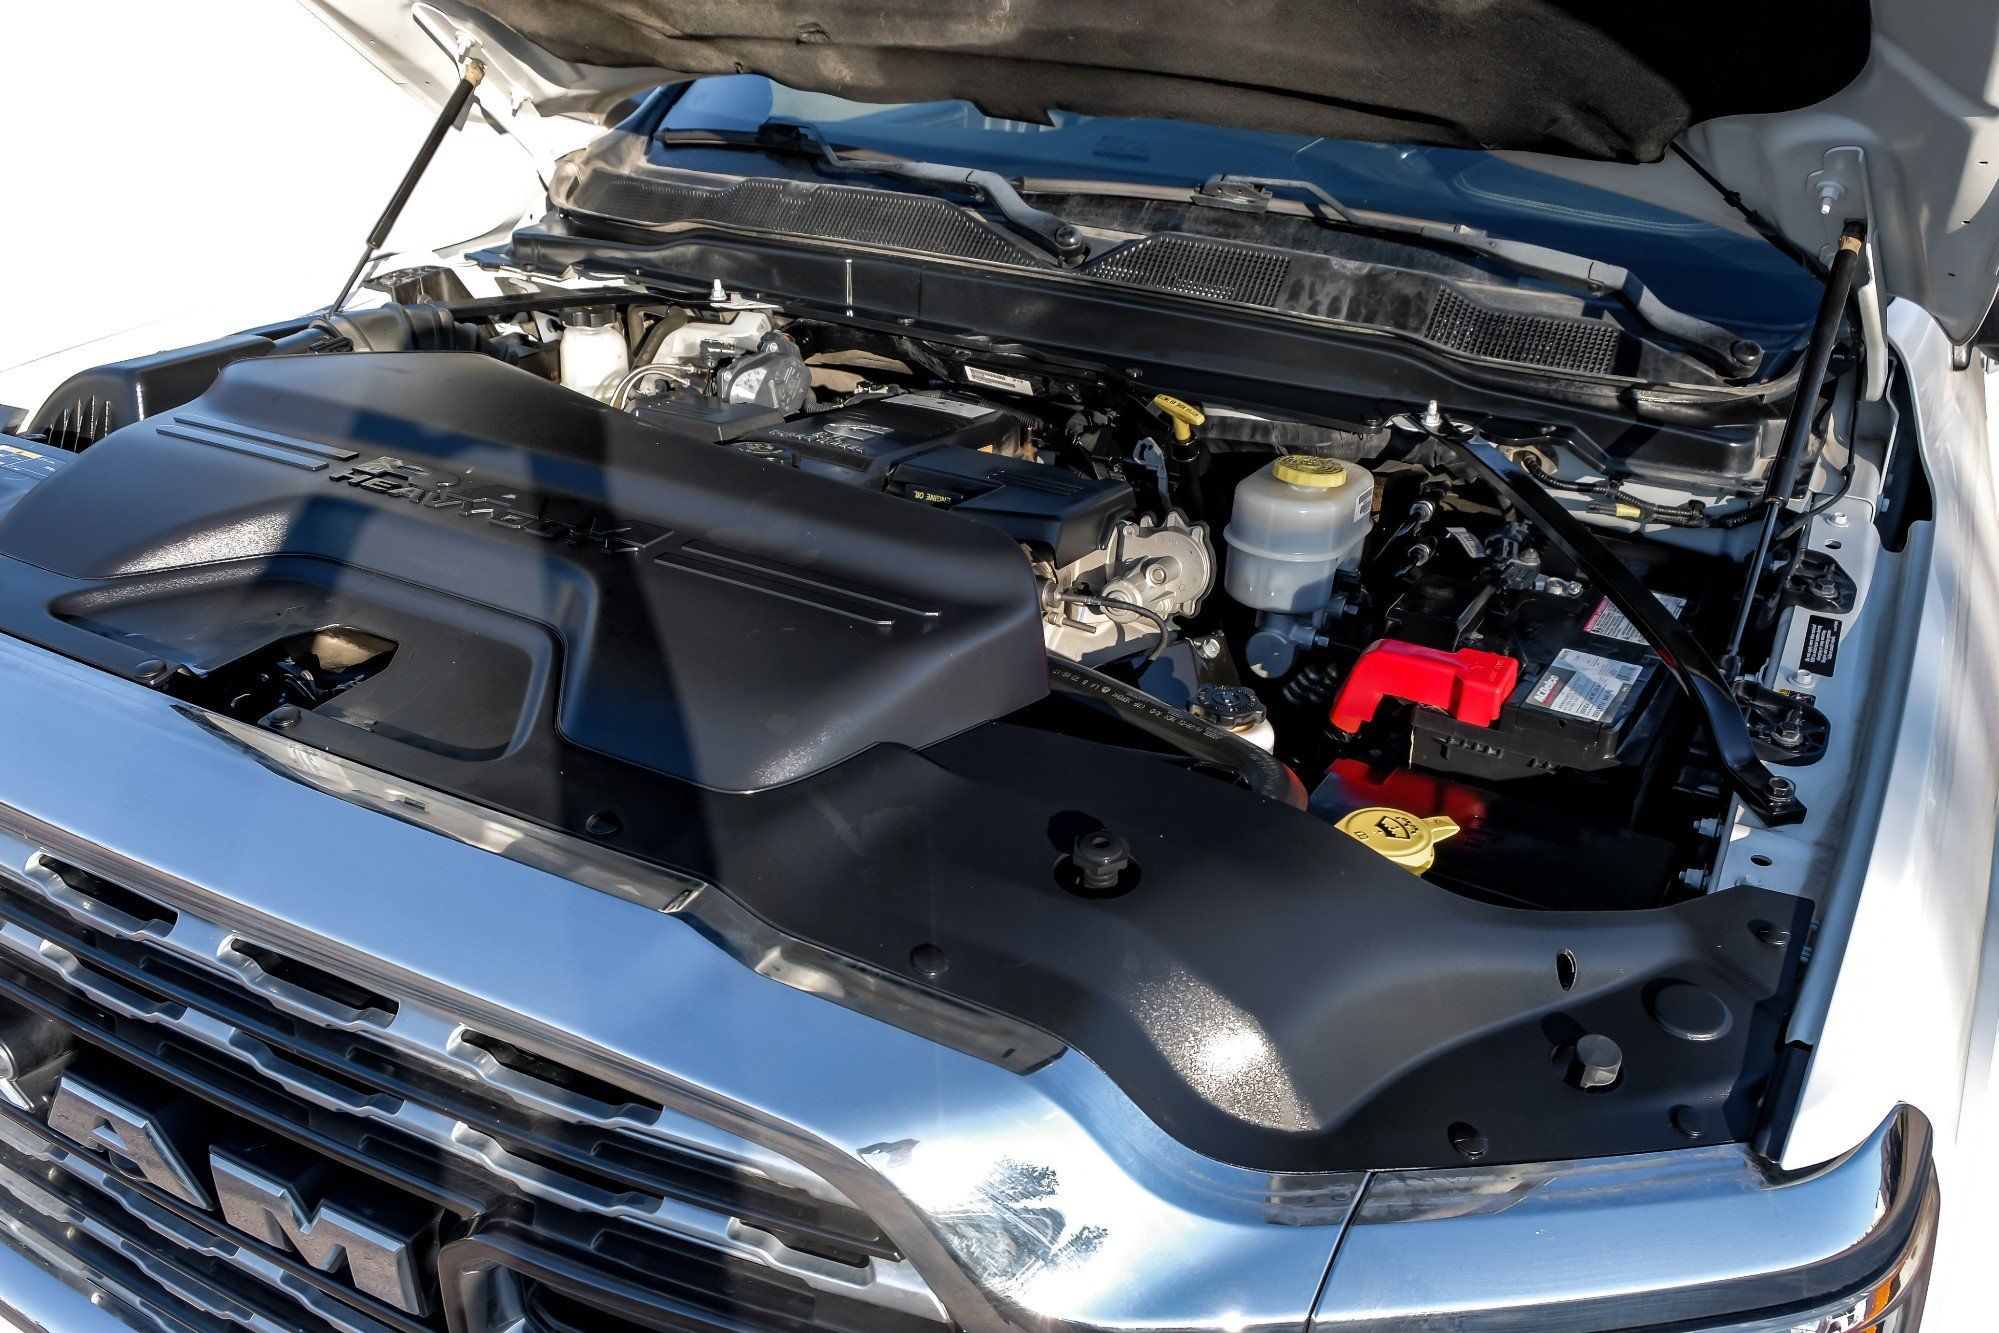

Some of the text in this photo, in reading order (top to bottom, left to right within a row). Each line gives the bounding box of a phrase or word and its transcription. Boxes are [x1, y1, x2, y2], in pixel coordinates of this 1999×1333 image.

[913, 490, 951, 503] ENGINE OIL
[1533, 674, 1560, 703] ACDelco
[0, 1040, 430, 1317] AM
